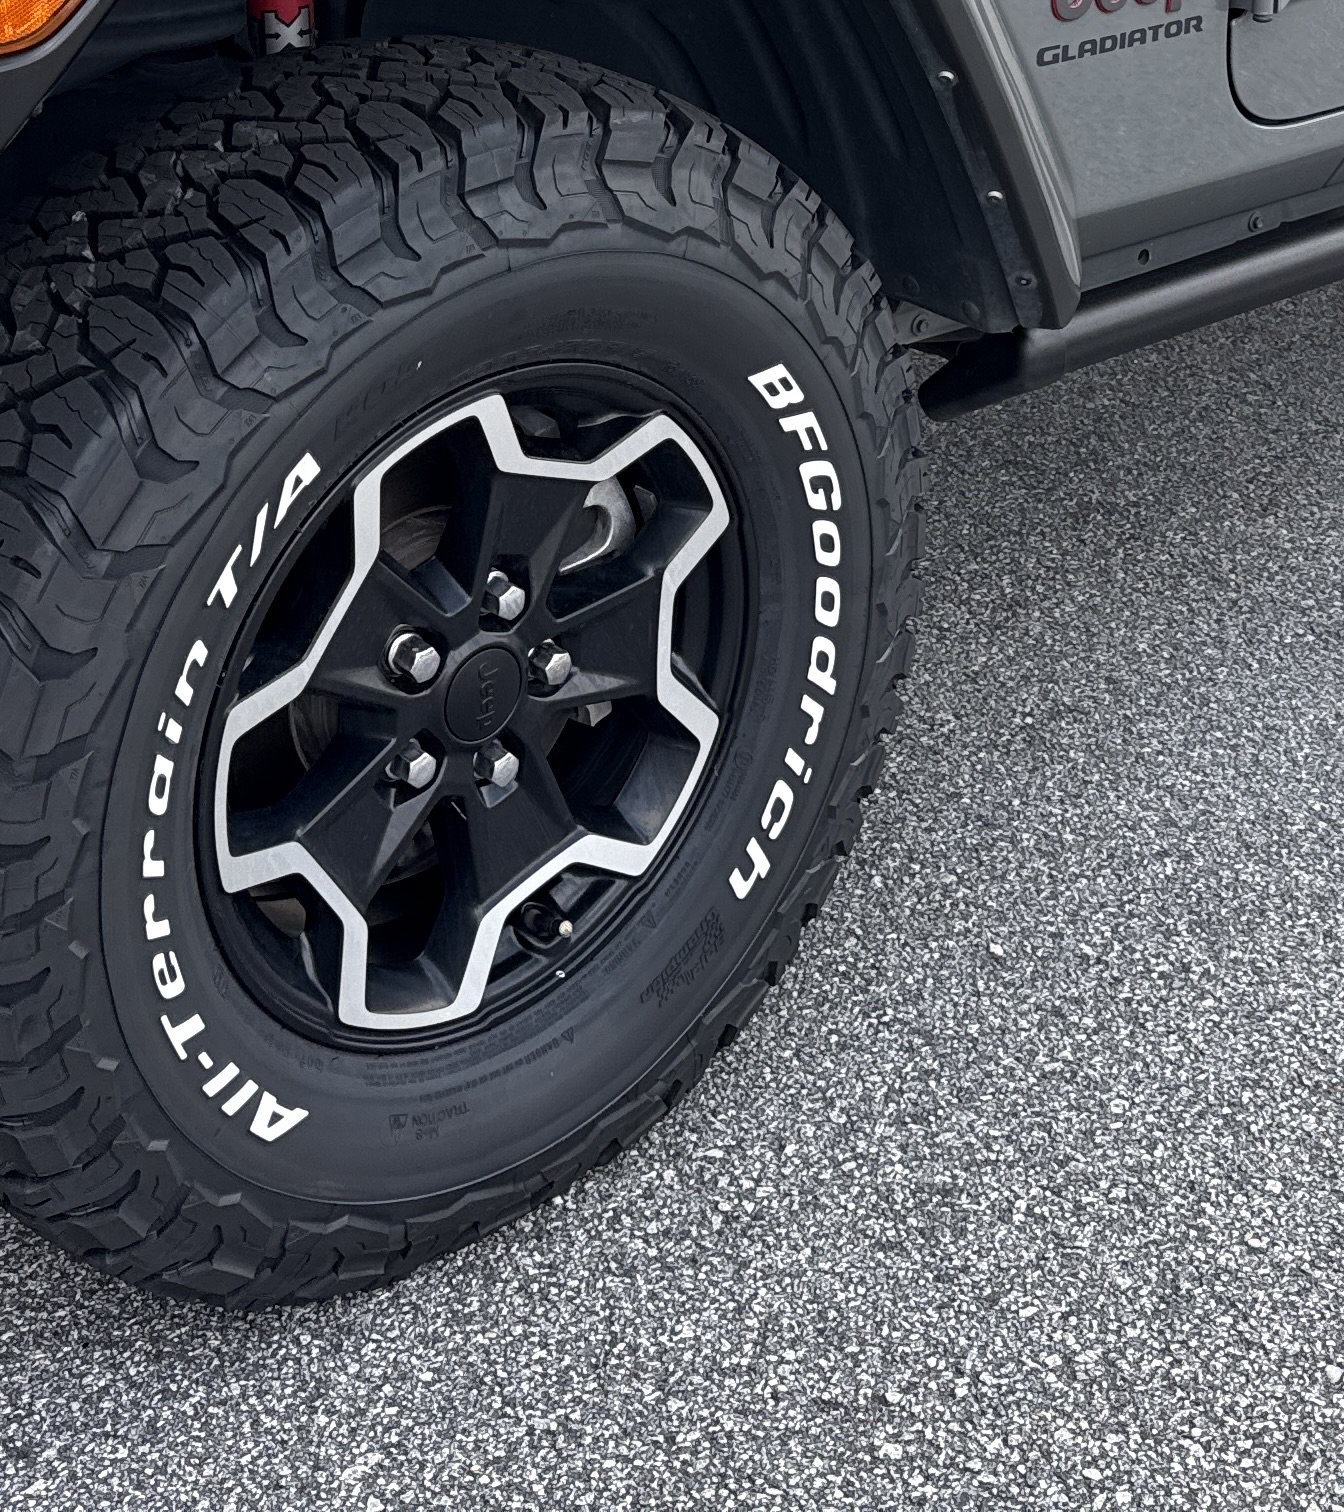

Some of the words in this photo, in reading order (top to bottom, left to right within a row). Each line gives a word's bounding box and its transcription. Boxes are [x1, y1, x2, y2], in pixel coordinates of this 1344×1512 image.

[1036, 15, 1203, 67] GLADIATOR
[206, 452, 321, 609] T/A
[727, 363, 842, 900] BFGoodrich
[143, 639, 310, 1142] All-Terrain
